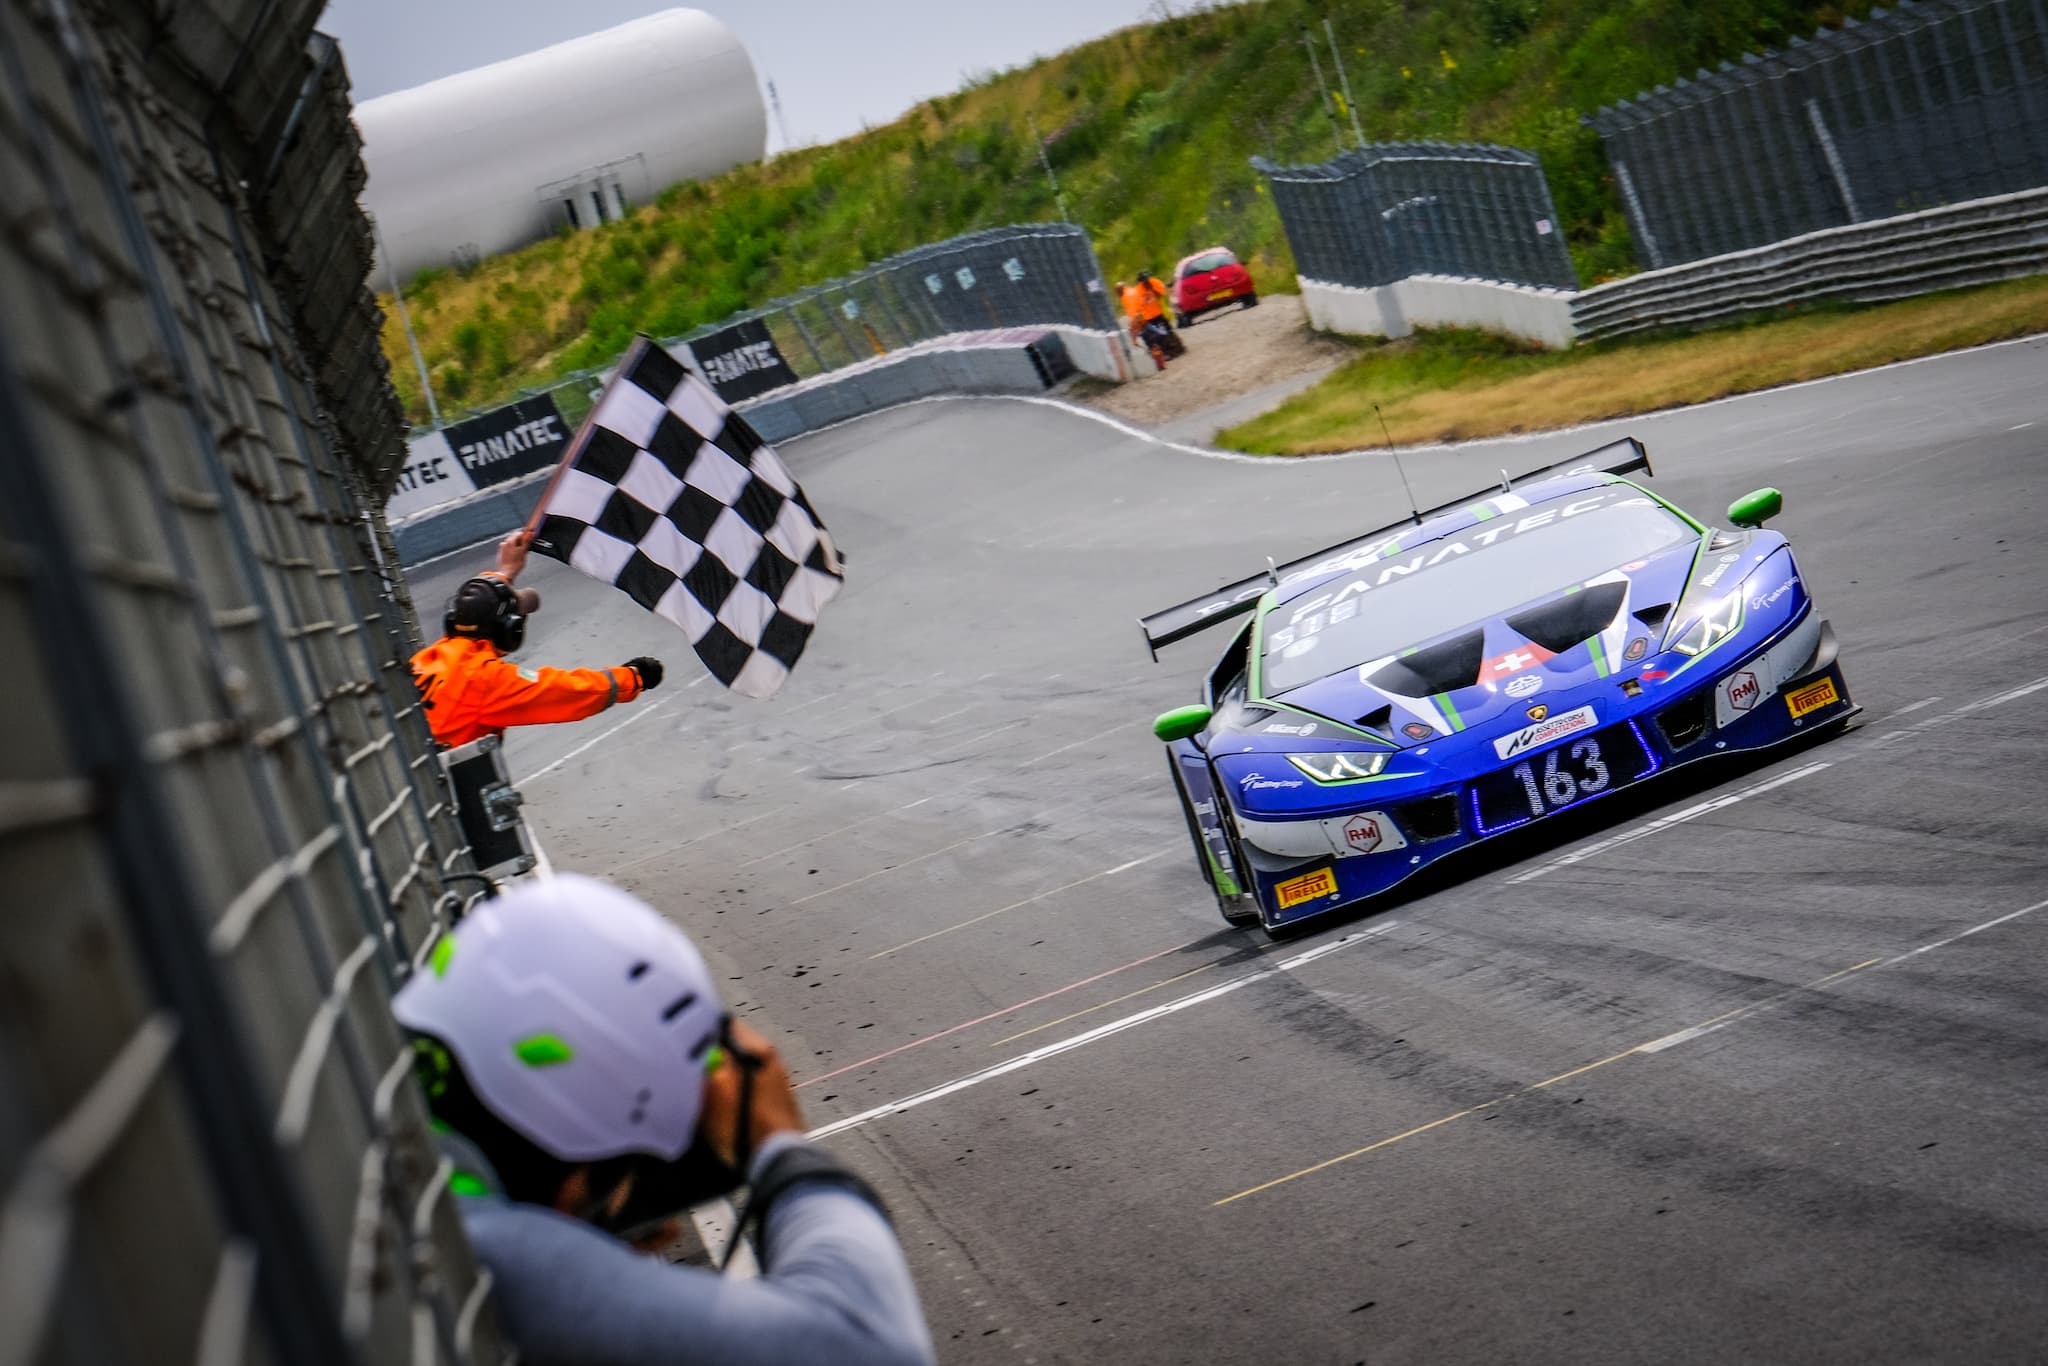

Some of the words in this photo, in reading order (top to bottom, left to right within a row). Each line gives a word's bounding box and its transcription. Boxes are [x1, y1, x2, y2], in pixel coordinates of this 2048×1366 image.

[703, 341, 779, 384] FANATEC
[459, 415, 563, 470] FANATEC
[1290, 496, 1606, 625] FANATEC
[1732, 680, 1756, 702] R-M
[1792, 682, 1834, 713] PIRELLI
[1512, 738, 1610, 816] 163
[1348, 826, 1377, 842] R-M
[1281, 873, 1329, 904] PIRELLI
